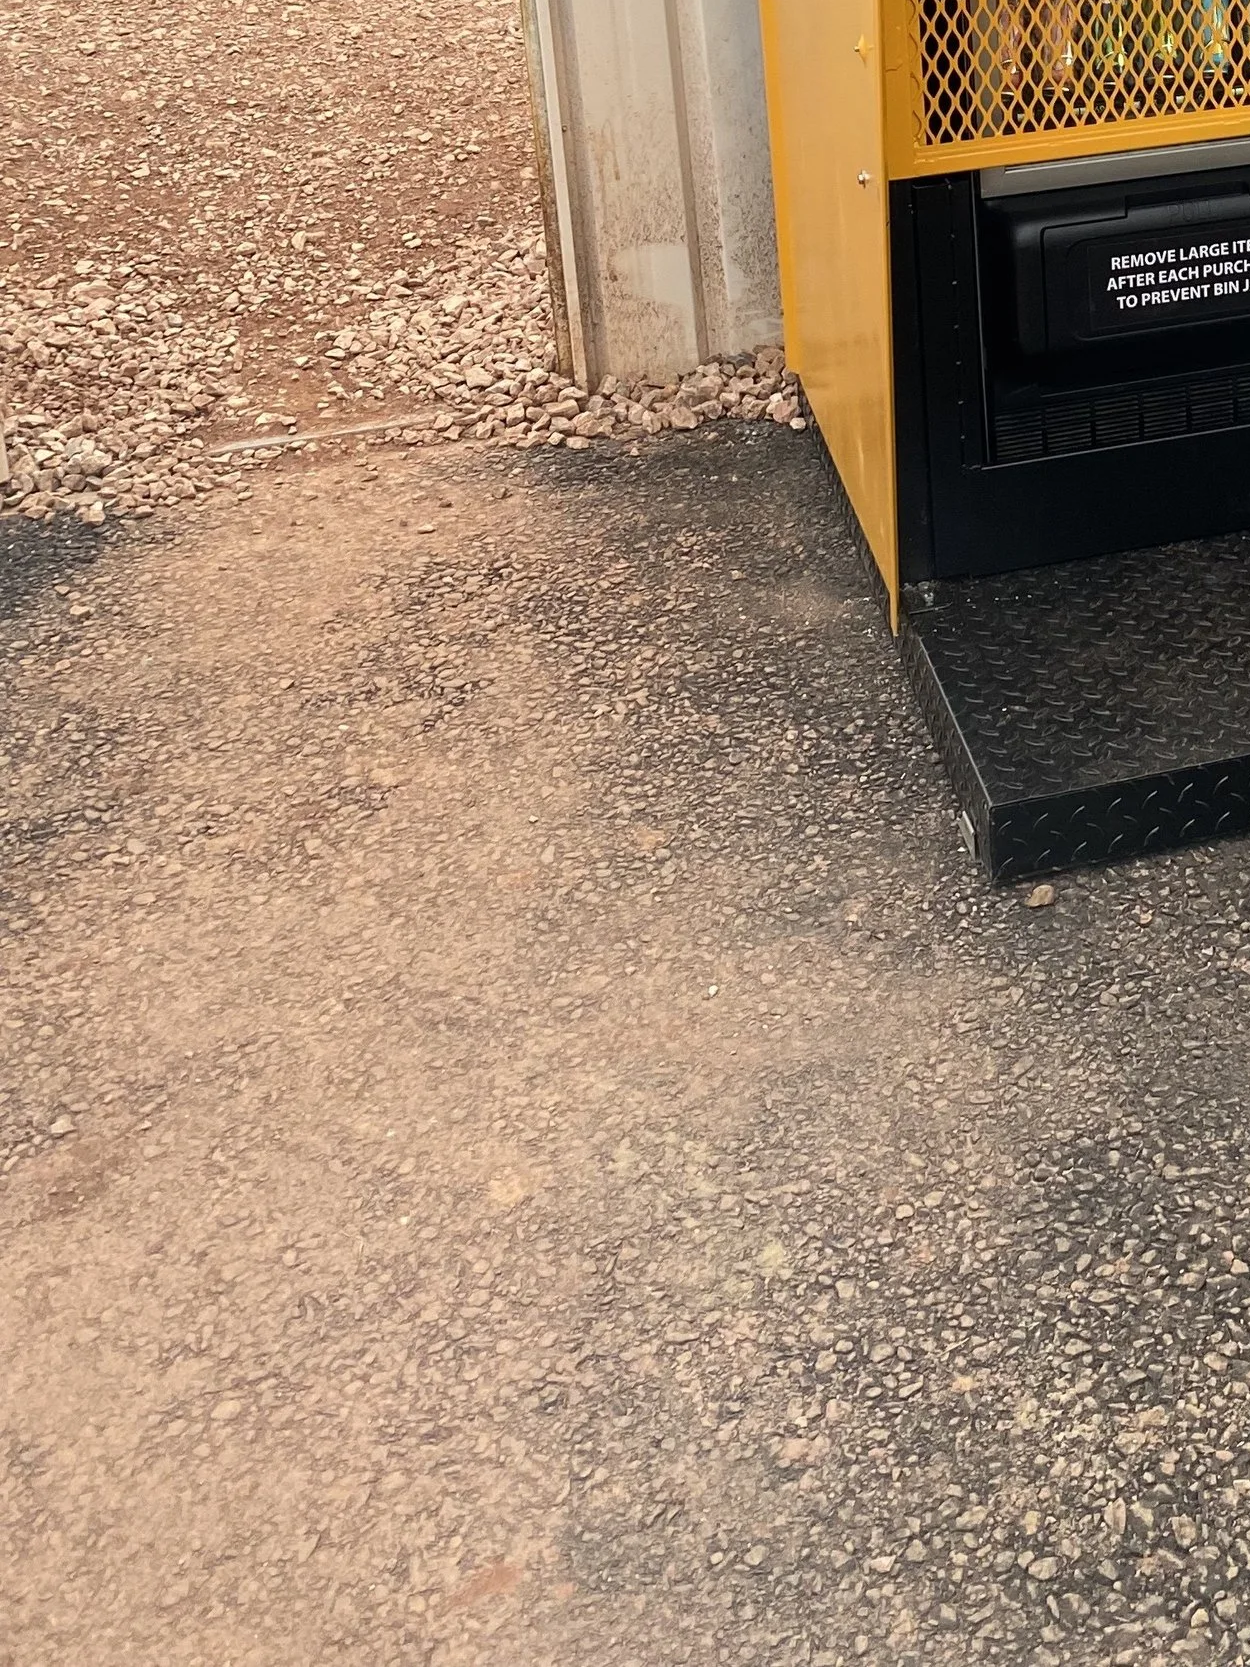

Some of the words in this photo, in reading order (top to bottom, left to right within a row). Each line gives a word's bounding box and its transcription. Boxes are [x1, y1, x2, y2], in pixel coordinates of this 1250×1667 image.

[1111, 249, 1176, 270] REMOVE
[1179, 242, 1229, 262] LARGE
[1106, 272, 1156, 291] AFTER
[1158, 266, 1200, 284] EACH
[1116, 296, 1138, 309] TO
[1142, 284, 1210, 306] PREVENT
[1214, 280, 1240, 296] BIN
